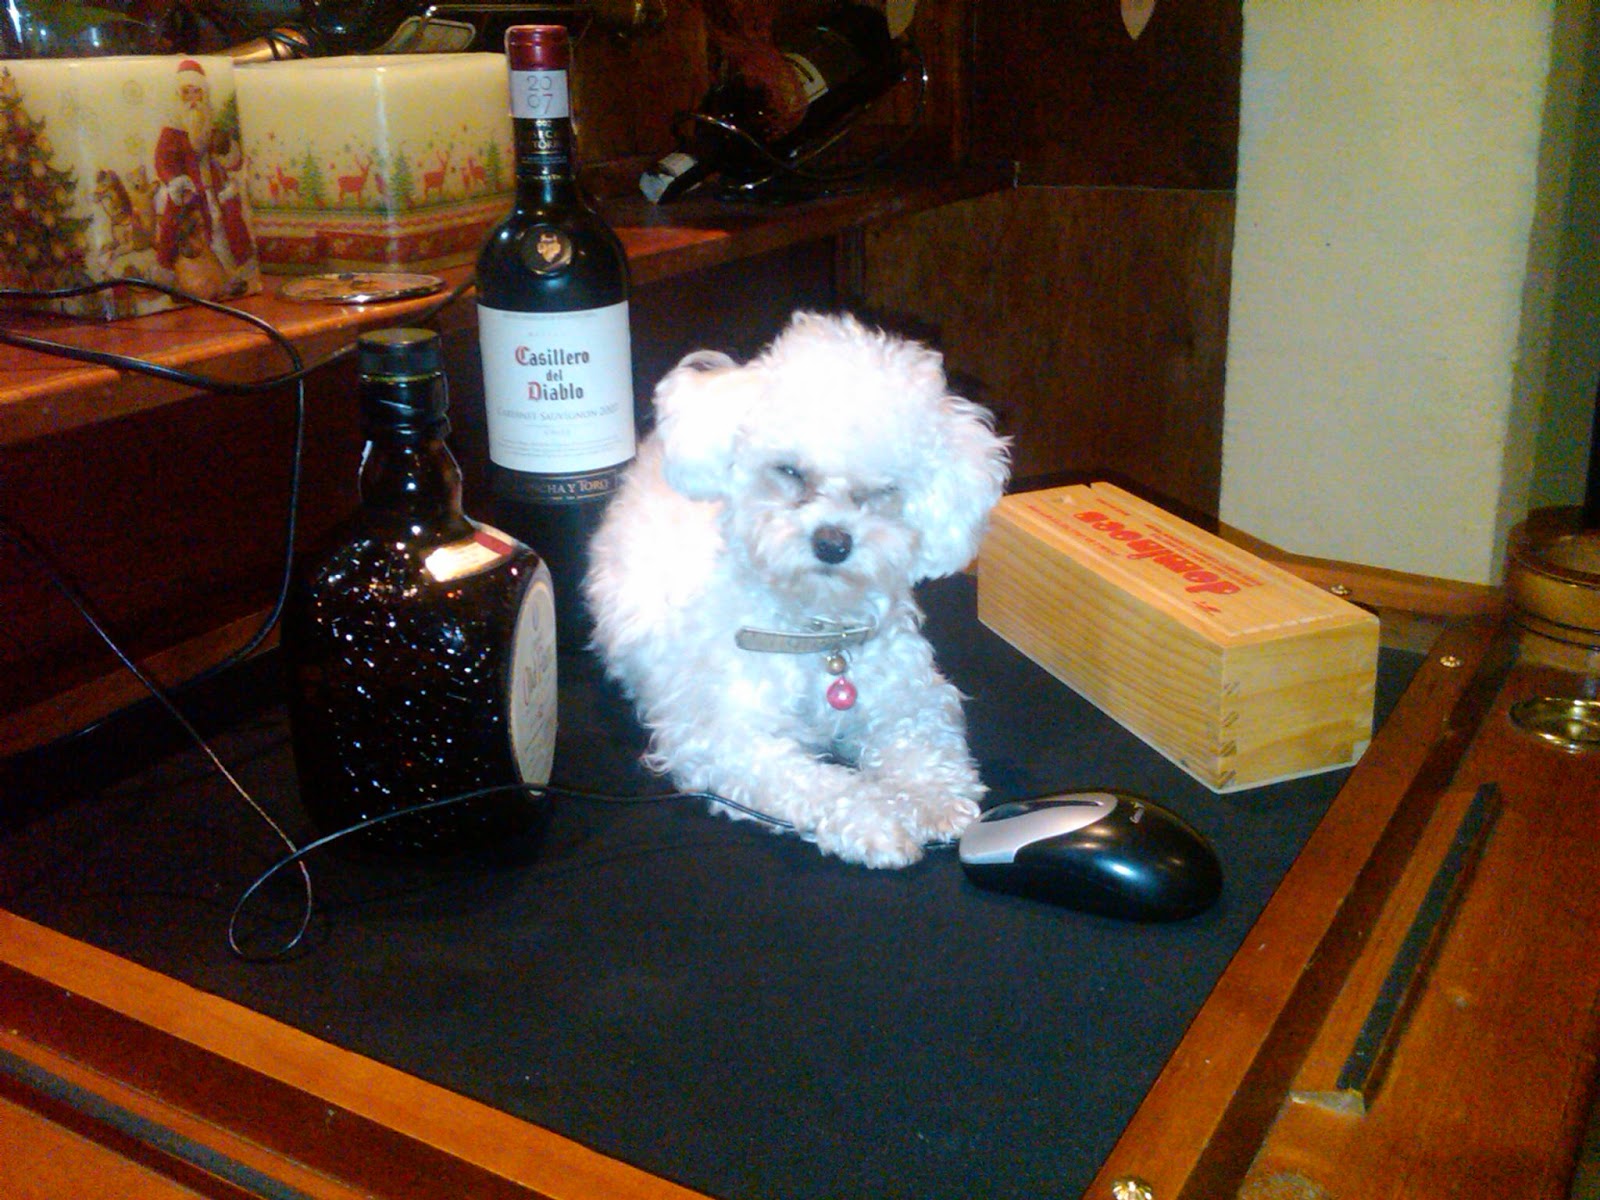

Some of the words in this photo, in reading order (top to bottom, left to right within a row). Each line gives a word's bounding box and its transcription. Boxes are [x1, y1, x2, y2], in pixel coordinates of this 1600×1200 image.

[526, 75, 552, 91] 20
[527, 93, 553, 115] 07
[514, 345, 590, 366] Casillero
[546, 369, 563, 382] del
[528, 381, 584, 402] Diablo
[567, 483, 576, 494] Y
[577, 479, 609, 492] TORO
[1073, 511, 1241, 595] dominoes
